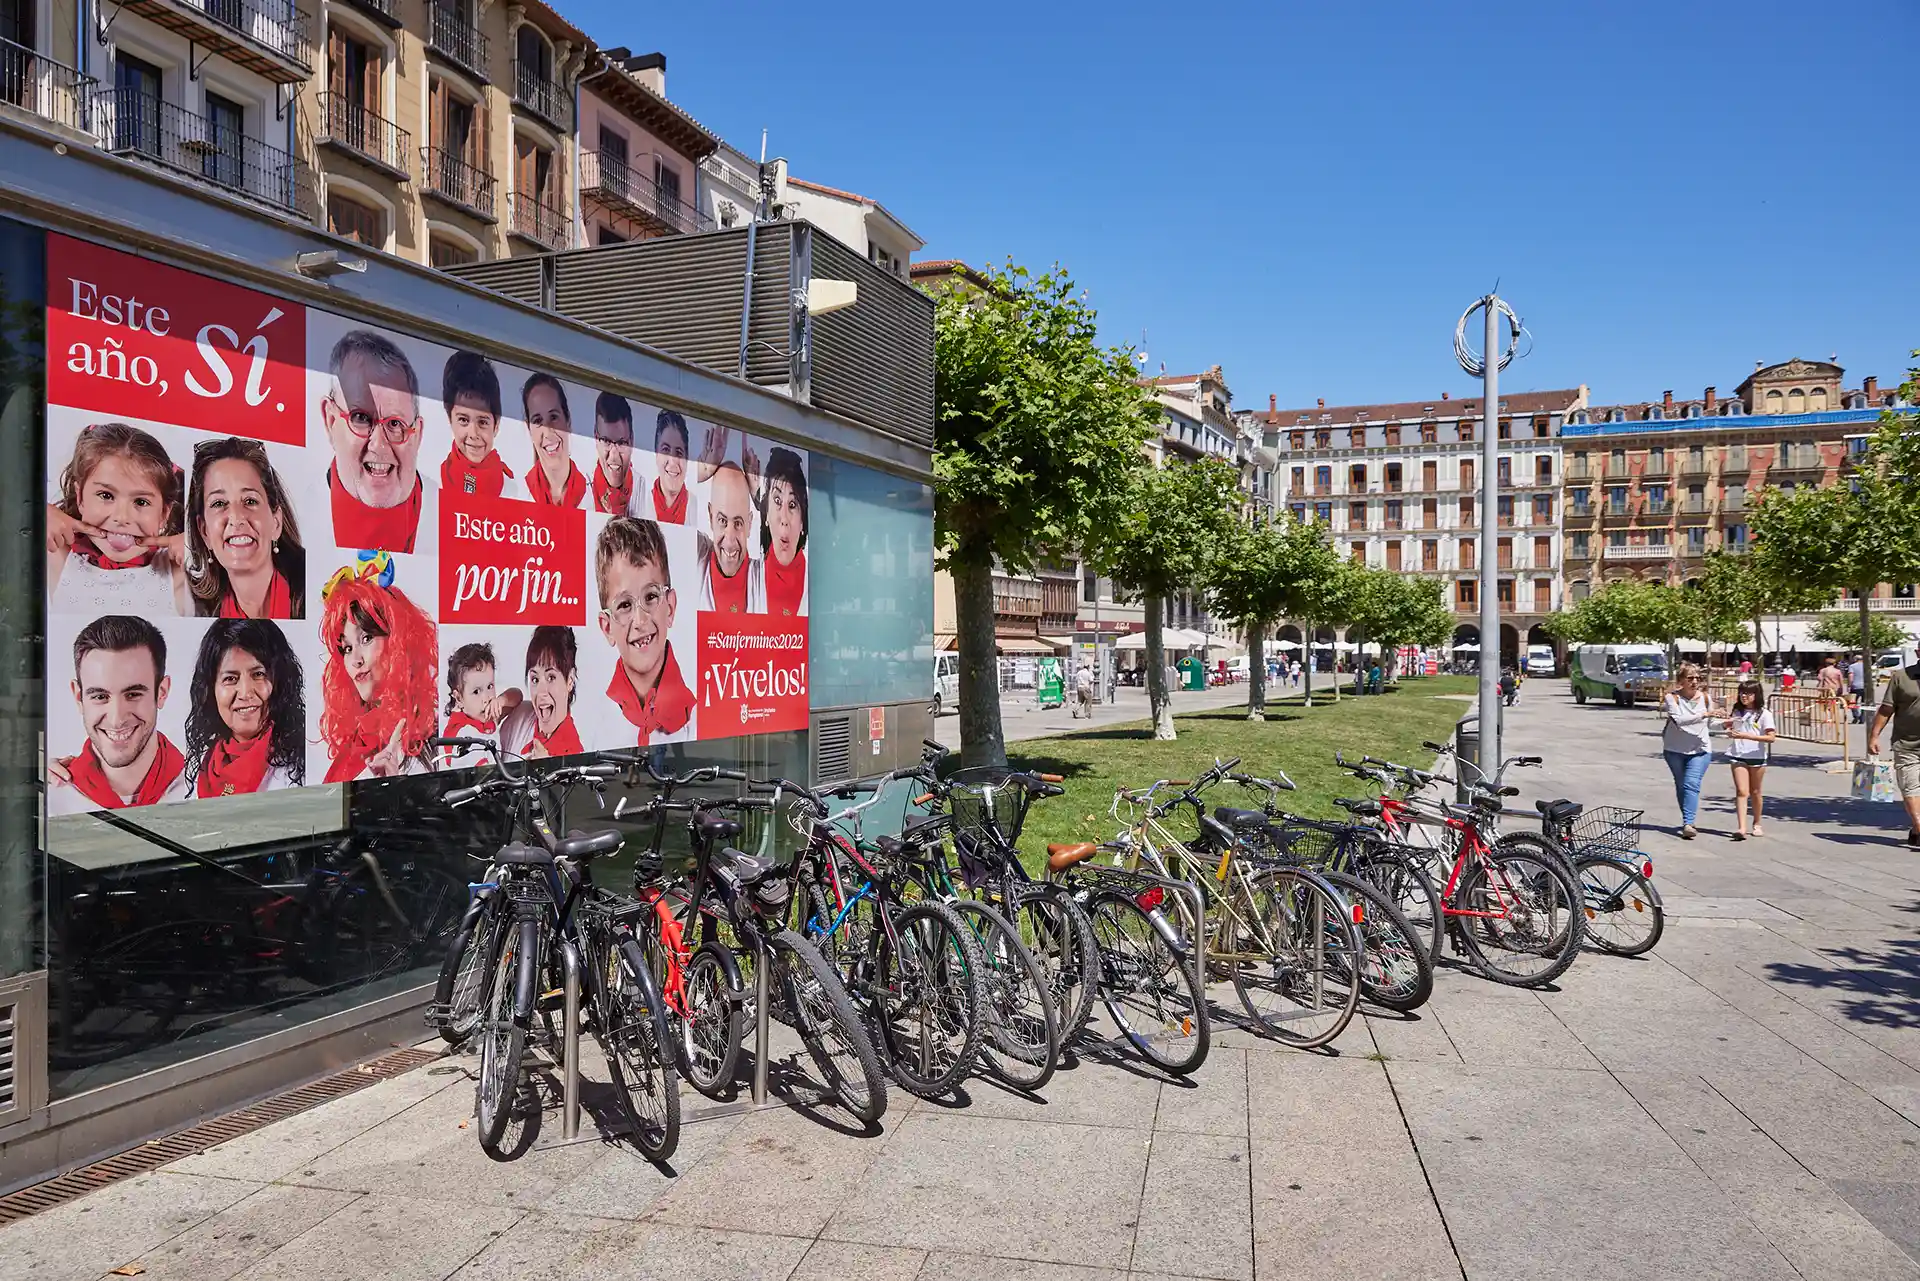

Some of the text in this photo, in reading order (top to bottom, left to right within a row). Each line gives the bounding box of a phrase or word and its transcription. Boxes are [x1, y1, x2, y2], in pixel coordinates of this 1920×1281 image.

[67, 277, 171, 337] Este
[67, 336, 169, 397] año,
[454, 511, 555, 552] Este año,
[453, 556, 579, 614] por fin...
[707, 630, 804, 653] #Sanfermines2022
[704, 657, 806, 707] ¡Vívelos!
